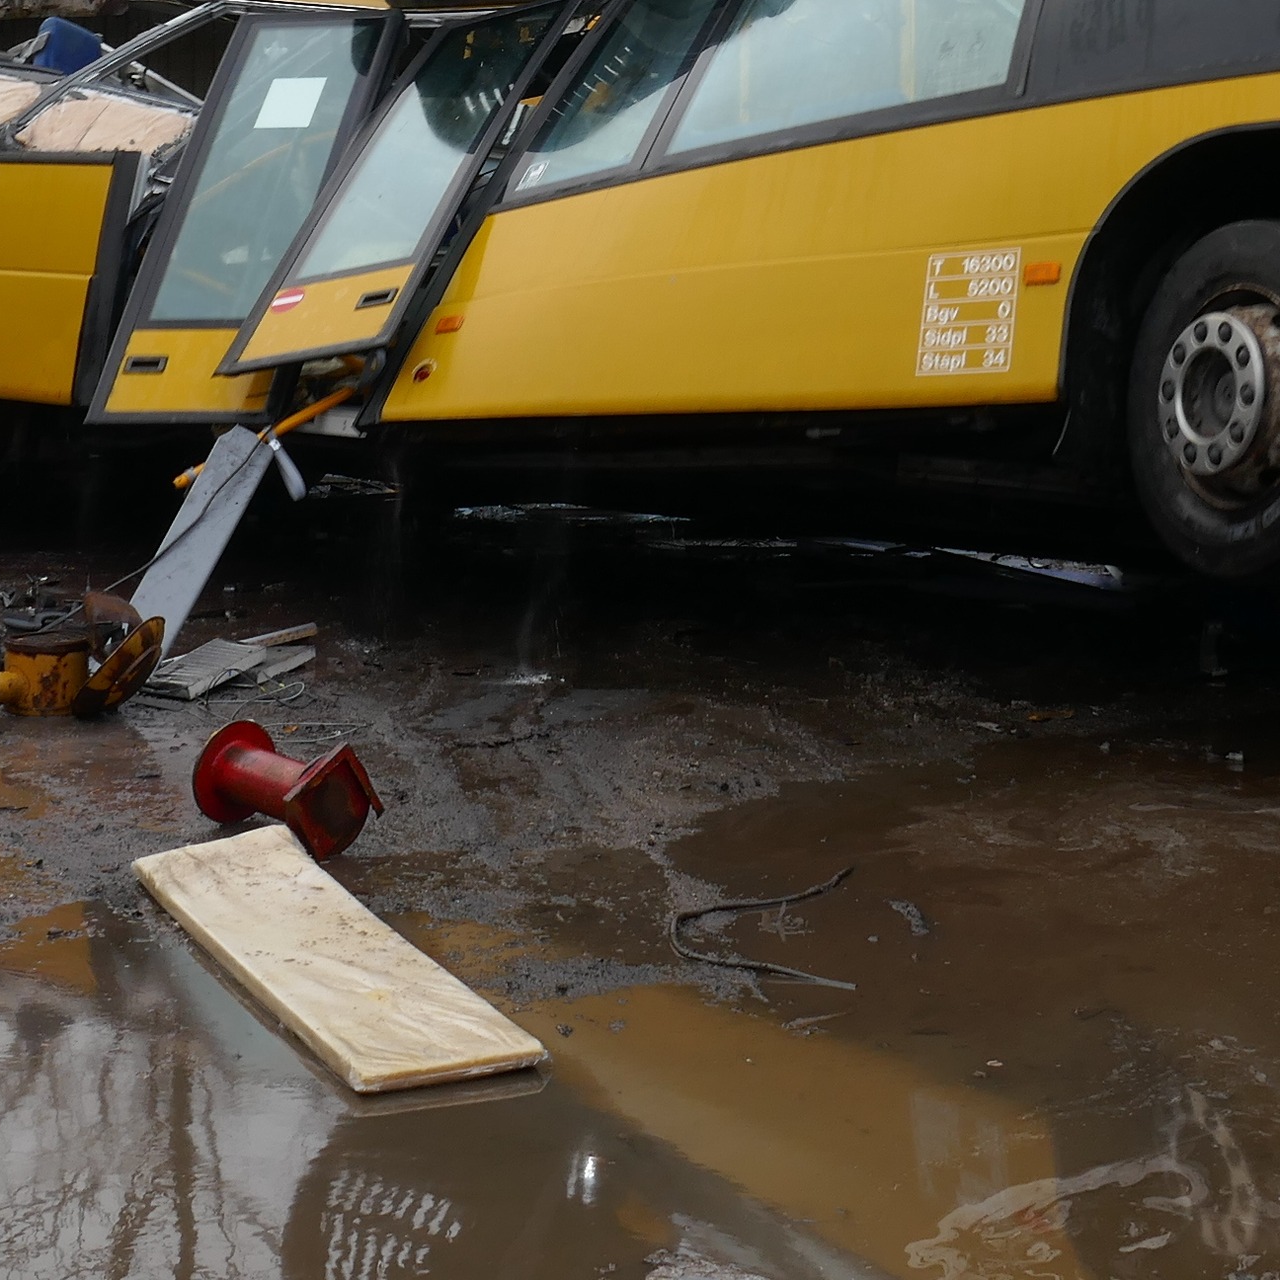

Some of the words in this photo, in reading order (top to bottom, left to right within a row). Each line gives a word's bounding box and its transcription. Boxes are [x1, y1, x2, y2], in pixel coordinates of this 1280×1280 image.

[932, 258, 945, 276] T
[961, 252, 1016, 275] 16300
[928, 281, 940, 300] L
[926, 303, 960, 325] Bgv
[997, 299, 1011, 319] 0
[923, 326, 968, 349] Sidpl
[984, 324, 1009, 344] 33
[982, 347, 1007, 368] 34
